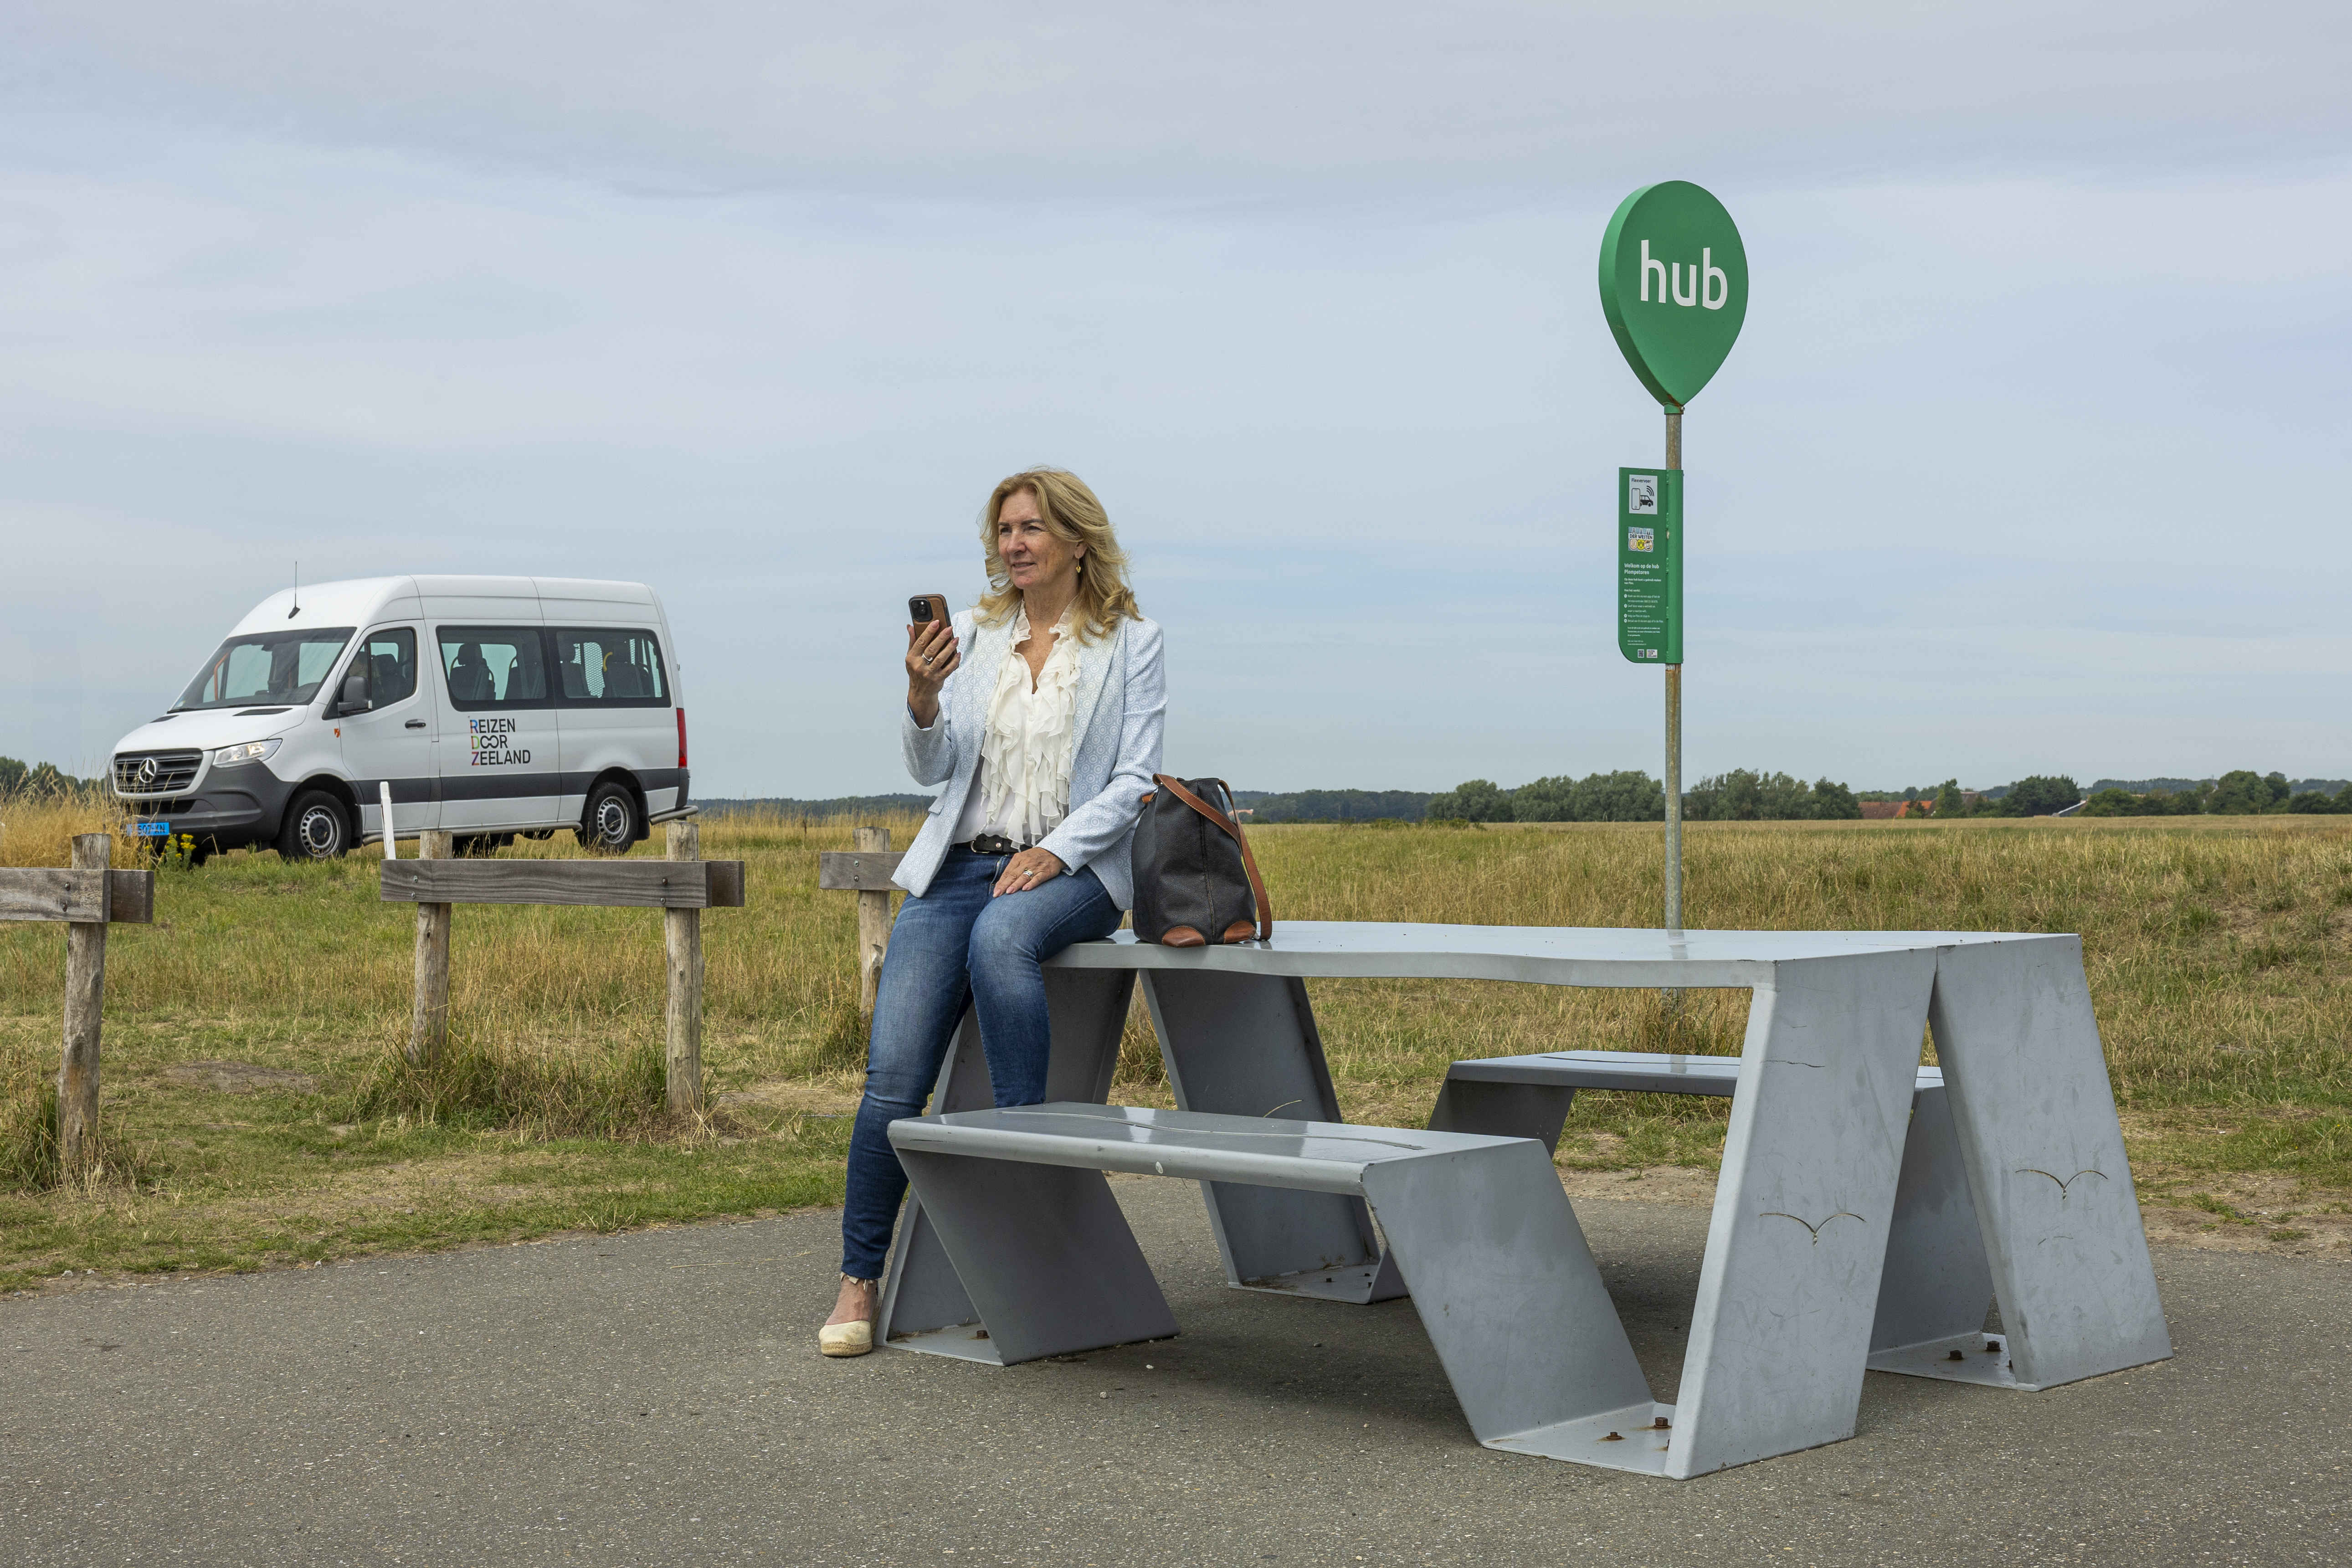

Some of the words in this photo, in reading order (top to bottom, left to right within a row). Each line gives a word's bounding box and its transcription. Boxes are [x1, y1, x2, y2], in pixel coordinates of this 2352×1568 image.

[1641, 240, 1728, 310] hub
[470, 719, 515, 734] REIZEN
[471, 735, 508, 750] DOOR
[472, 750, 531, 766] ZEELAND
